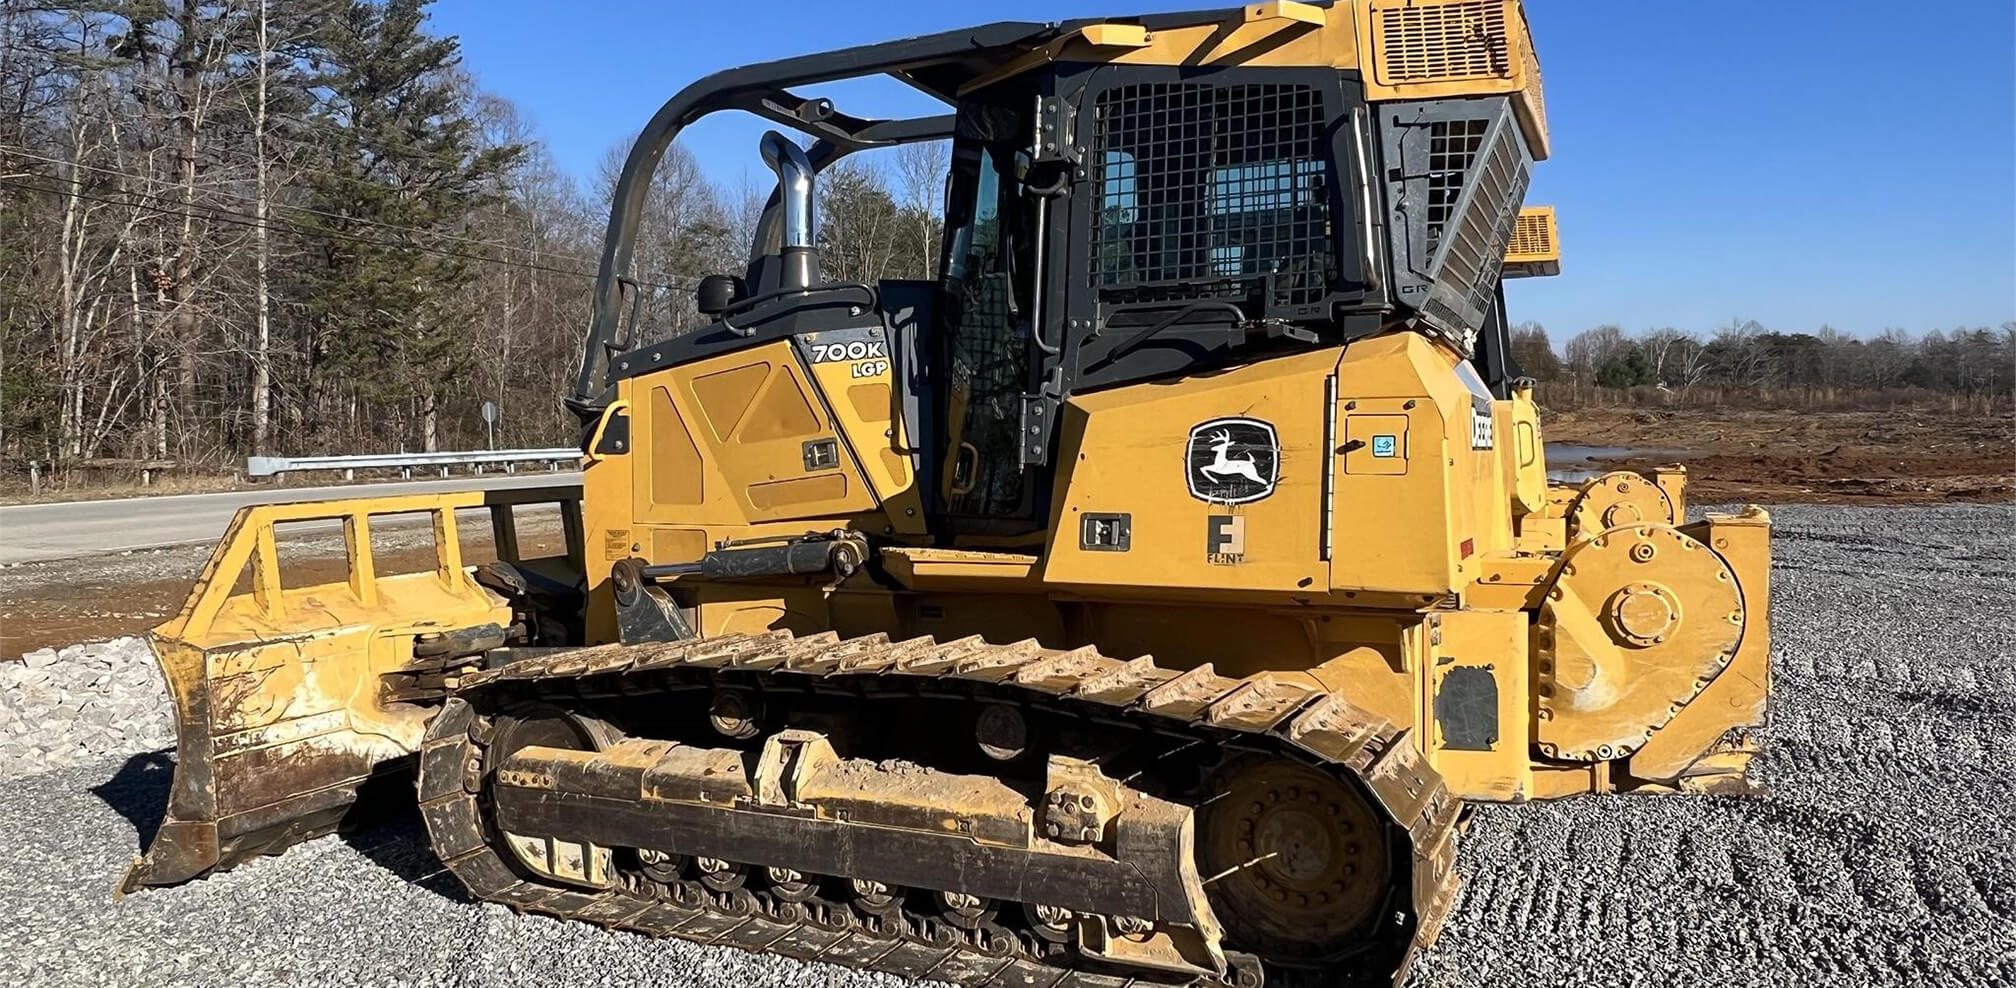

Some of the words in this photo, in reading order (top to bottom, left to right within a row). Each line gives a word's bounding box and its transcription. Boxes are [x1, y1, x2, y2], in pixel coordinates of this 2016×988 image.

[811, 341, 887, 363] 700K
[851, 360, 888, 379] LGP
[1207, 553, 1244, 564] FLINT
